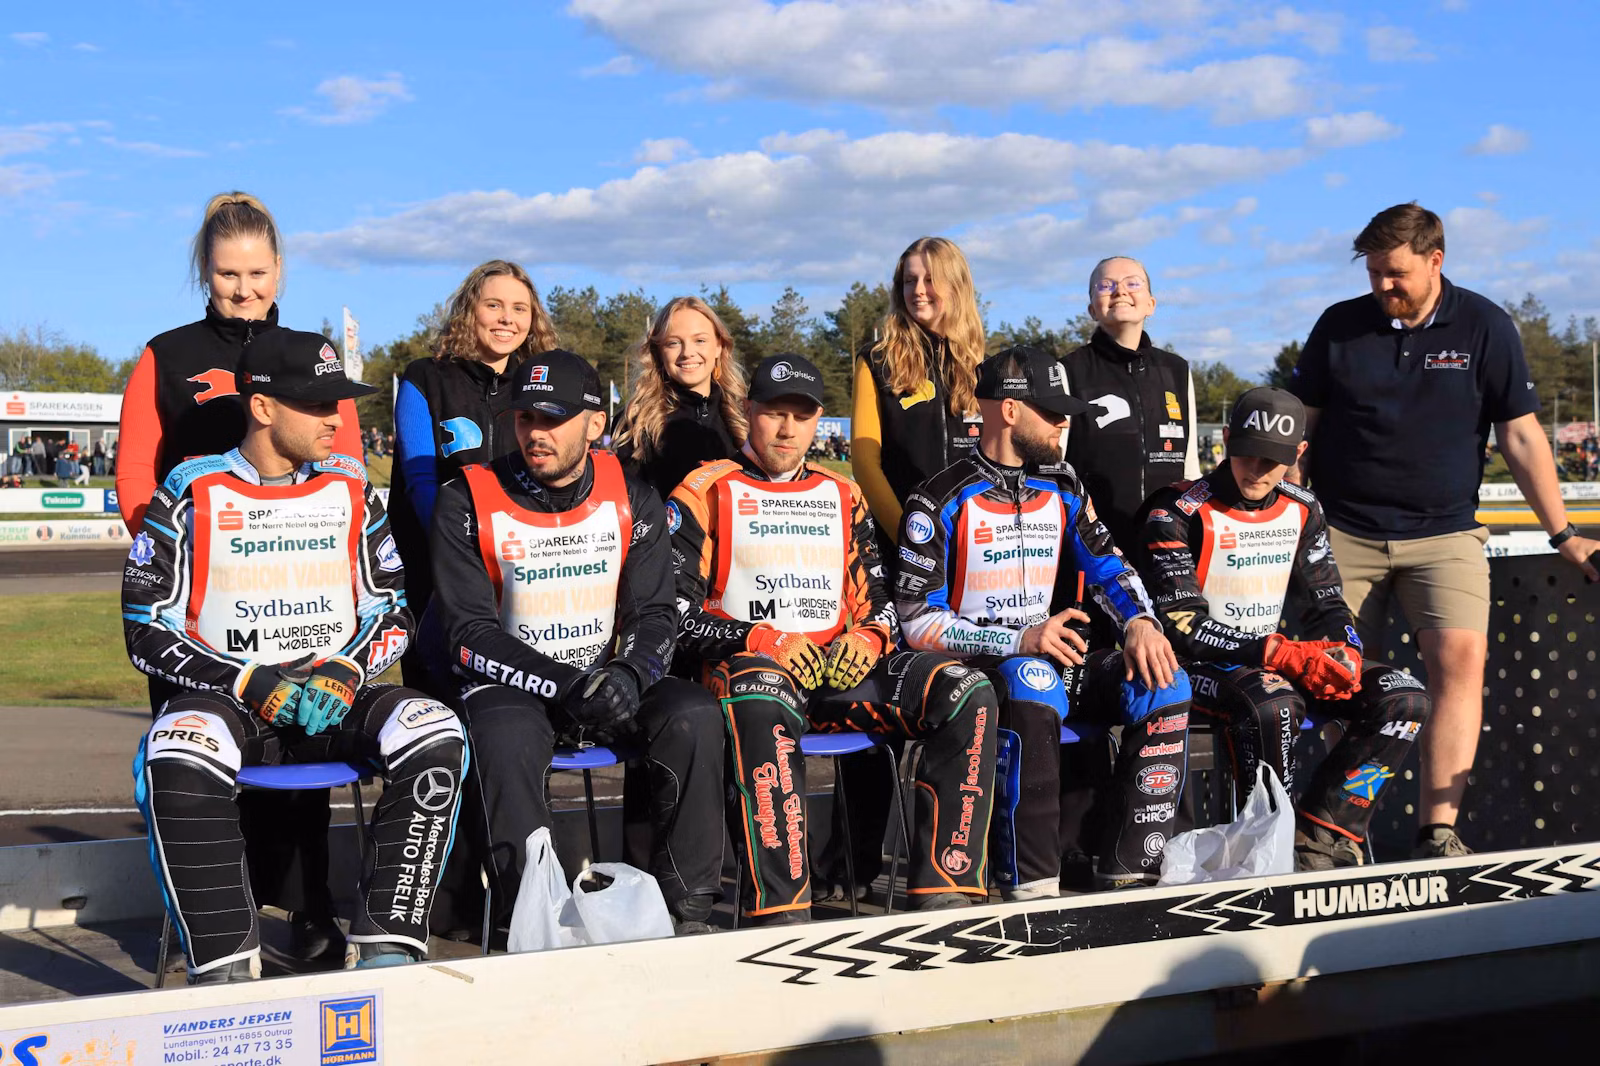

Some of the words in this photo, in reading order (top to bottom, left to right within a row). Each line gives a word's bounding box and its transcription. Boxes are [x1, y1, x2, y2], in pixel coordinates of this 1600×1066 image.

[522, 384, 554, 392] BETARD
[29, 401, 103, 411] SPAREKASSEN
[1242, 409, 1295, 436] AVO
[761, 499, 837, 510] SPAREKASSEN
[817, 511, 837, 519] Omegn
[285, 521, 307, 529] Nebel
[320, 520, 346, 528] Omegn
[749, 521, 831, 538] Sparinvest
[908, 520, 929, 537] ATPI
[995, 523, 1058, 534] SPAREKASSEN
[1239, 528, 1298, 540] SPAREKASSEN
[60, 533, 101, 541] Kommune
[230, 535, 336, 557] Sparinvest
[983, 545, 1054, 565] Sparinvest
[1226, 551, 1291, 570] Sparinvest
[514, 559, 608, 585] Sparinvest
[968, 567, 1022, 592] REGION
[755, 573, 832, 594] Sydbank
[235, 595, 334, 622] Sydbank
[749, 599, 776, 621] LM
[985, 592, 1045, 612] Sydbank
[226, 629, 259, 652] LM
[263, 622, 343, 640] LAURIDSENS
[518, 618, 604, 646] Sydbank
[1194, 629, 1240, 651] Limtræ
[278, 636, 331, 651] MØBLER
[545, 640, 607, 661] AURIDSENS
[131, 654, 226, 692] Metalkas
[567, 655, 600, 669] ØBLER
[473, 652, 558, 699] BETARD
[324, 679, 354, 701] LEATT
[734, 684, 747, 692] CB
[748, 684, 779, 694] AUTO
[779, 690, 798, 709] RIBE
[949, 688, 962, 702] CB
[959, 672, 980, 692] AUTO
[263, 694, 281, 720] EATT
[152, 730, 220, 753] PRES
[959, 706, 988, 797] Jacobsens
[772, 724, 796, 794] Morten
[1144, 774, 1173, 785] STS
[753, 762, 783, 849] Transport
[1134, 808, 1175, 823] CHROM
[1146, 802, 1172, 812] NIKKEL
[951, 795, 975, 846] Ernst
[402, 811, 428, 859] AUTO
[410, 814, 447, 925] Mercedes-Benz
[389, 863, 416, 922] FRELIK
[1293, 875, 1449, 919] HUMBAUR
[163, 1017, 236, 1034] V/ANDERS
[239, 1011, 292, 1026] JEPSEN
[338, 1014, 359, 1037] H
[163, 1037, 216, 1050] Lundtangvej
[239, 1031, 262, 1041] 6855
[264, 1028, 293, 1038] Outrup
[164, 1048, 208, 1064] Mobil.:
[213, 1046, 230, 1058] 24
[234, 1043, 250, 1055] 47
[254, 1040, 271, 1053] 73
[275, 1038, 293, 1050] 35
